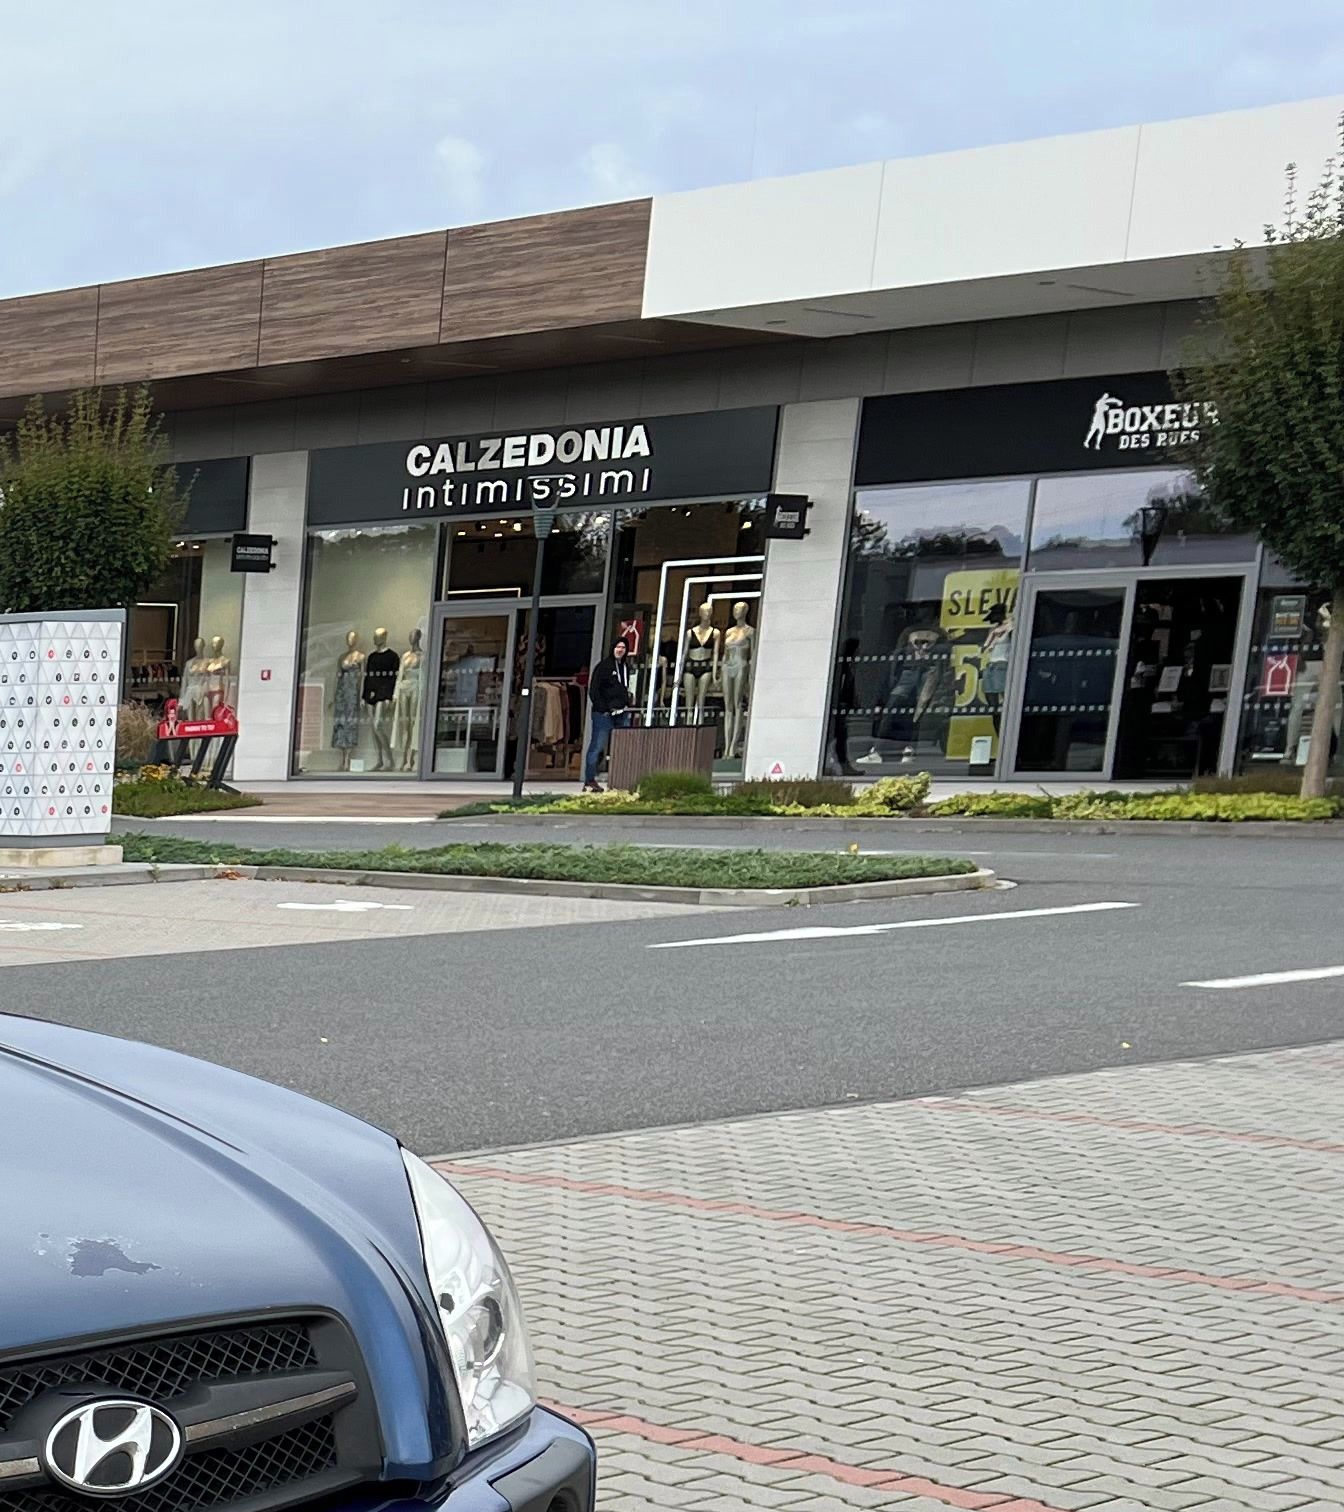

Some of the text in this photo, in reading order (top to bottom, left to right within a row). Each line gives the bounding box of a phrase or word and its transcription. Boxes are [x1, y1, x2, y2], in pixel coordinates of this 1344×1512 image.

[406, 424, 651, 477] CALZEDONIA
[1118, 430, 1200, 449] DES RUES
[402, 468, 650, 510] intimissimi
